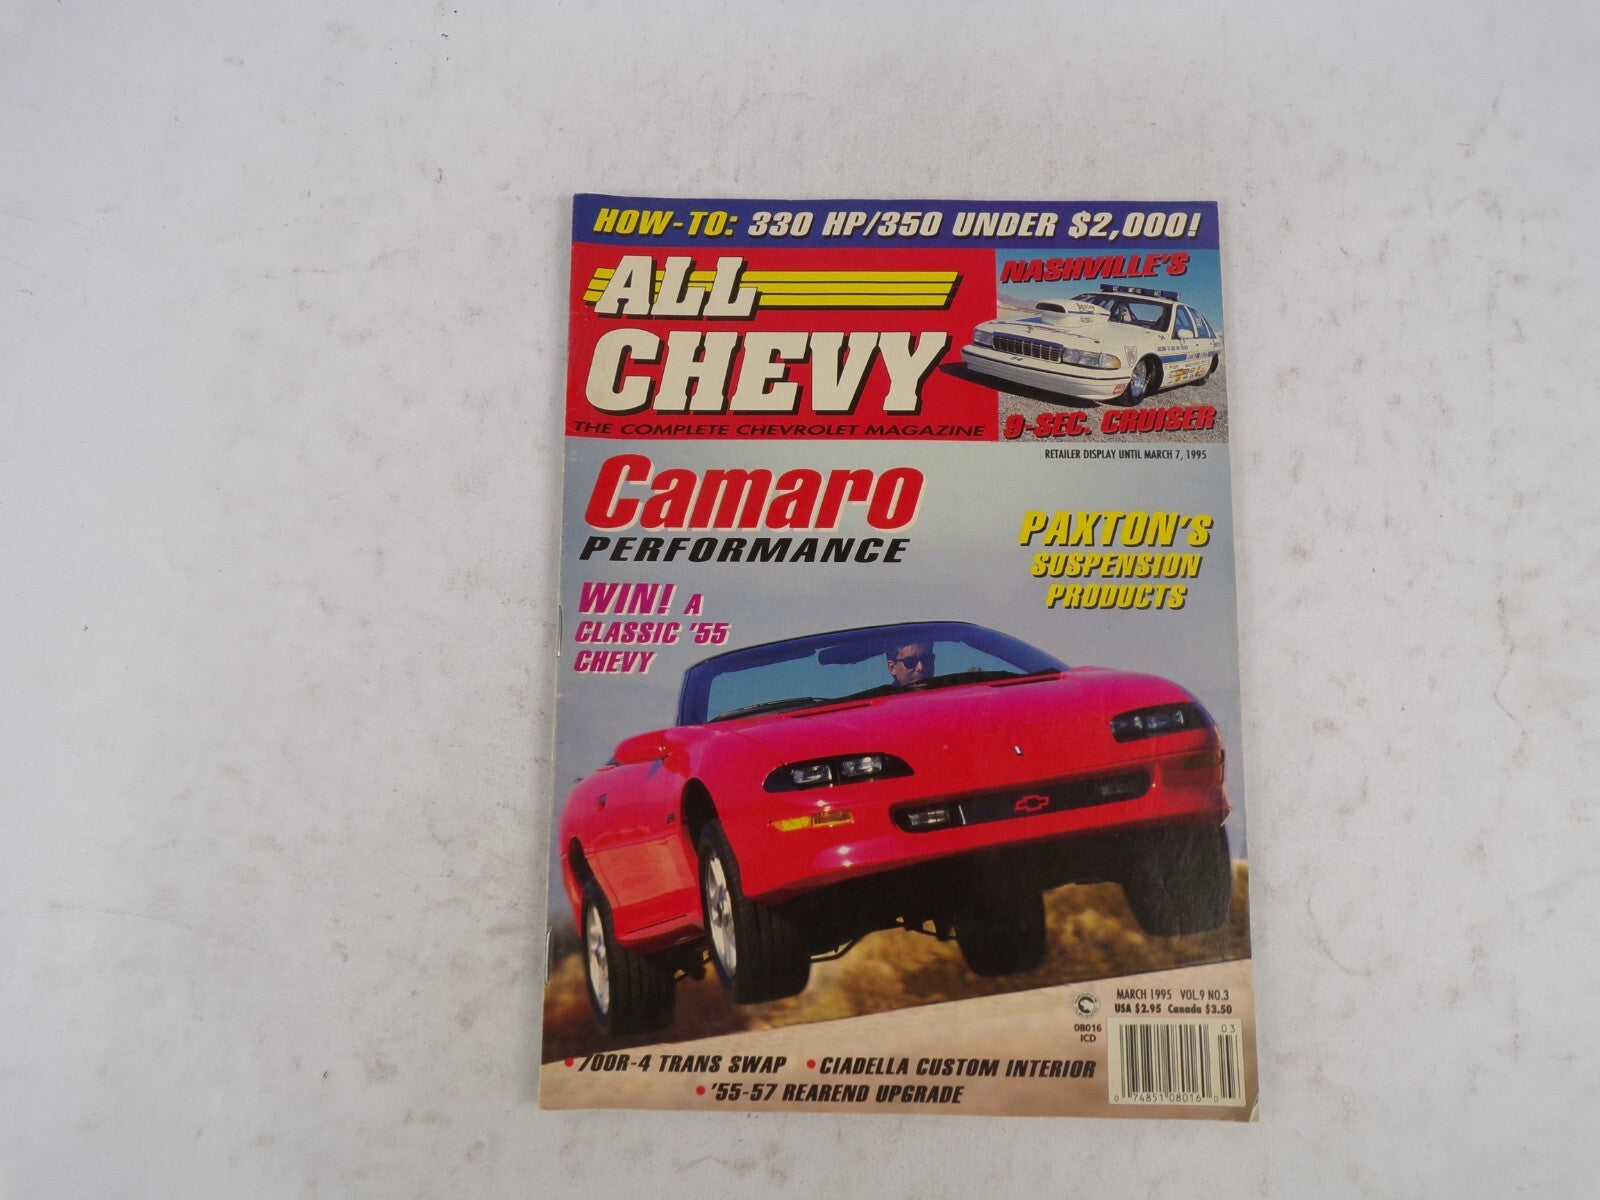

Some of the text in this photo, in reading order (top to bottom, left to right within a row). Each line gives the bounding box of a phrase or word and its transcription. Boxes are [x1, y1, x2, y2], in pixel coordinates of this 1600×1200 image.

[593, 207, 1201, 240] HOW-TO: 330 HP/350 UNDER $2,000!
[1000, 252, 1190, 284] NASHVILLE'S
[594, 255, 762, 319] ALL
[585, 328, 952, 415] CHEVY
[573, 420, 985, 437] THE COMPLETE CHEVROLET MAGAZINE
[1003, 405, 1217, 439] 9-SEC. CRUISER
[1045, 449, 1207, 461] RETAILER DISPLAY UNTIL MARCH 7, 1995
[584, 453, 926, 533] Camaro
[1017, 510, 1214, 547] PAXTON'S
[579, 536, 911, 563] PERFORMANCE
[1030, 552, 1204, 578] SUSPENSION
[578, 582, 705, 616] WIN! A
[1045, 583, 1188, 610] PRODUCTS
[574, 621, 731, 646] CLASSIC '55
[573, 650, 656, 675] CHEVY
[1116, 988, 1147, 1000] MARCH
[1150, 988, 1172, 1000] 1995
[1115, 1002, 1232, 1015] USA $2.95 Canada $3.50
[1074, 1023, 1102, 1032] 08016
[1080, 1034, 1097, 1042] ICD
[659, 1055, 723, 1074] TRANS
[728, 1056, 787, 1074] SWAP
[819, 1056, 1097, 1079] CIADELLA CUSTOM INTERIOR
[711, 1083, 965, 1104] '55-57 REAREND UPGRADE
[1133, 1093, 1164, 1102] 74851
[1169, 1093, 1202, 1102] 08016
